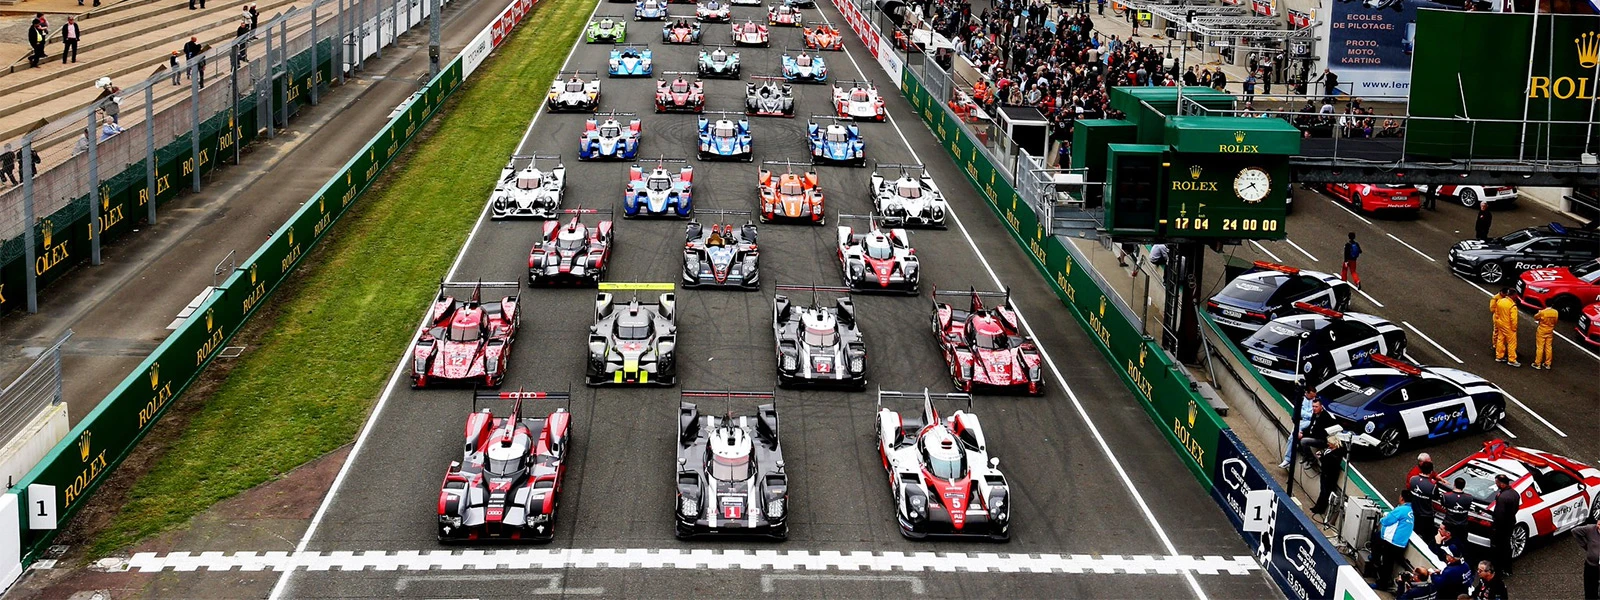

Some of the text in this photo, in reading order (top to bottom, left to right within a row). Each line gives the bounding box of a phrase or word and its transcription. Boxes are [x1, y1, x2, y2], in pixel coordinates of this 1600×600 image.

[1347, 22, 1395, 30] PILOTAGE:
[1345, 40, 1380, 48] PROTO,
[1347, 48, 1376, 56] MOTO,
[1528, 76, 1600, 100] ROL
[219, 125, 243, 151] ROLX
[1219, 144, 1260, 154] ROLEX
[182, 148, 210, 177] ROEX
[138, 173, 171, 206] ROEX
[1171, 180, 1218, 191] ROLEX
[314, 211, 331, 238] ROLEX
[1175, 217, 1277, 231] 17 04 24 00 00
[35, 239, 70, 276] OLEX
[281, 243, 301, 273] ROLEX
[1030, 237, 1047, 266] ROLEX
[1514, 261, 1543, 270] Race
[1057, 271, 1076, 303] ROLEX
[243, 280, 266, 315] ROLEX
[1090, 311, 1111, 348] ROLEX
[196, 326, 224, 366] ROLEX
[451, 357, 464, 366] 12
[1352, 349, 1369, 361] Safety
[819, 363, 828, 372] 2
[993, 363, 1005, 373] 13
[1127, 359, 1153, 402] ROLEX
[1400, 388, 1409, 401] B
[138, 381, 172, 429] ROLEX
[1428, 409, 1464, 424] Safety Car
[1174, 416, 1205, 469] ROLEX
[64, 449, 107, 508] ROLEX
[495, 481, 508, 490] 7
[36, 500, 48, 517] 1
[729, 506, 736, 518] 1
[952, 498, 961, 509] 5
[1553, 501, 1584, 518] Safety Car
[1253, 505, 1263, 521] 1
[1299, 545, 1317, 568] CIRCUIT
[1309, 575, 1325, 597] MANS
